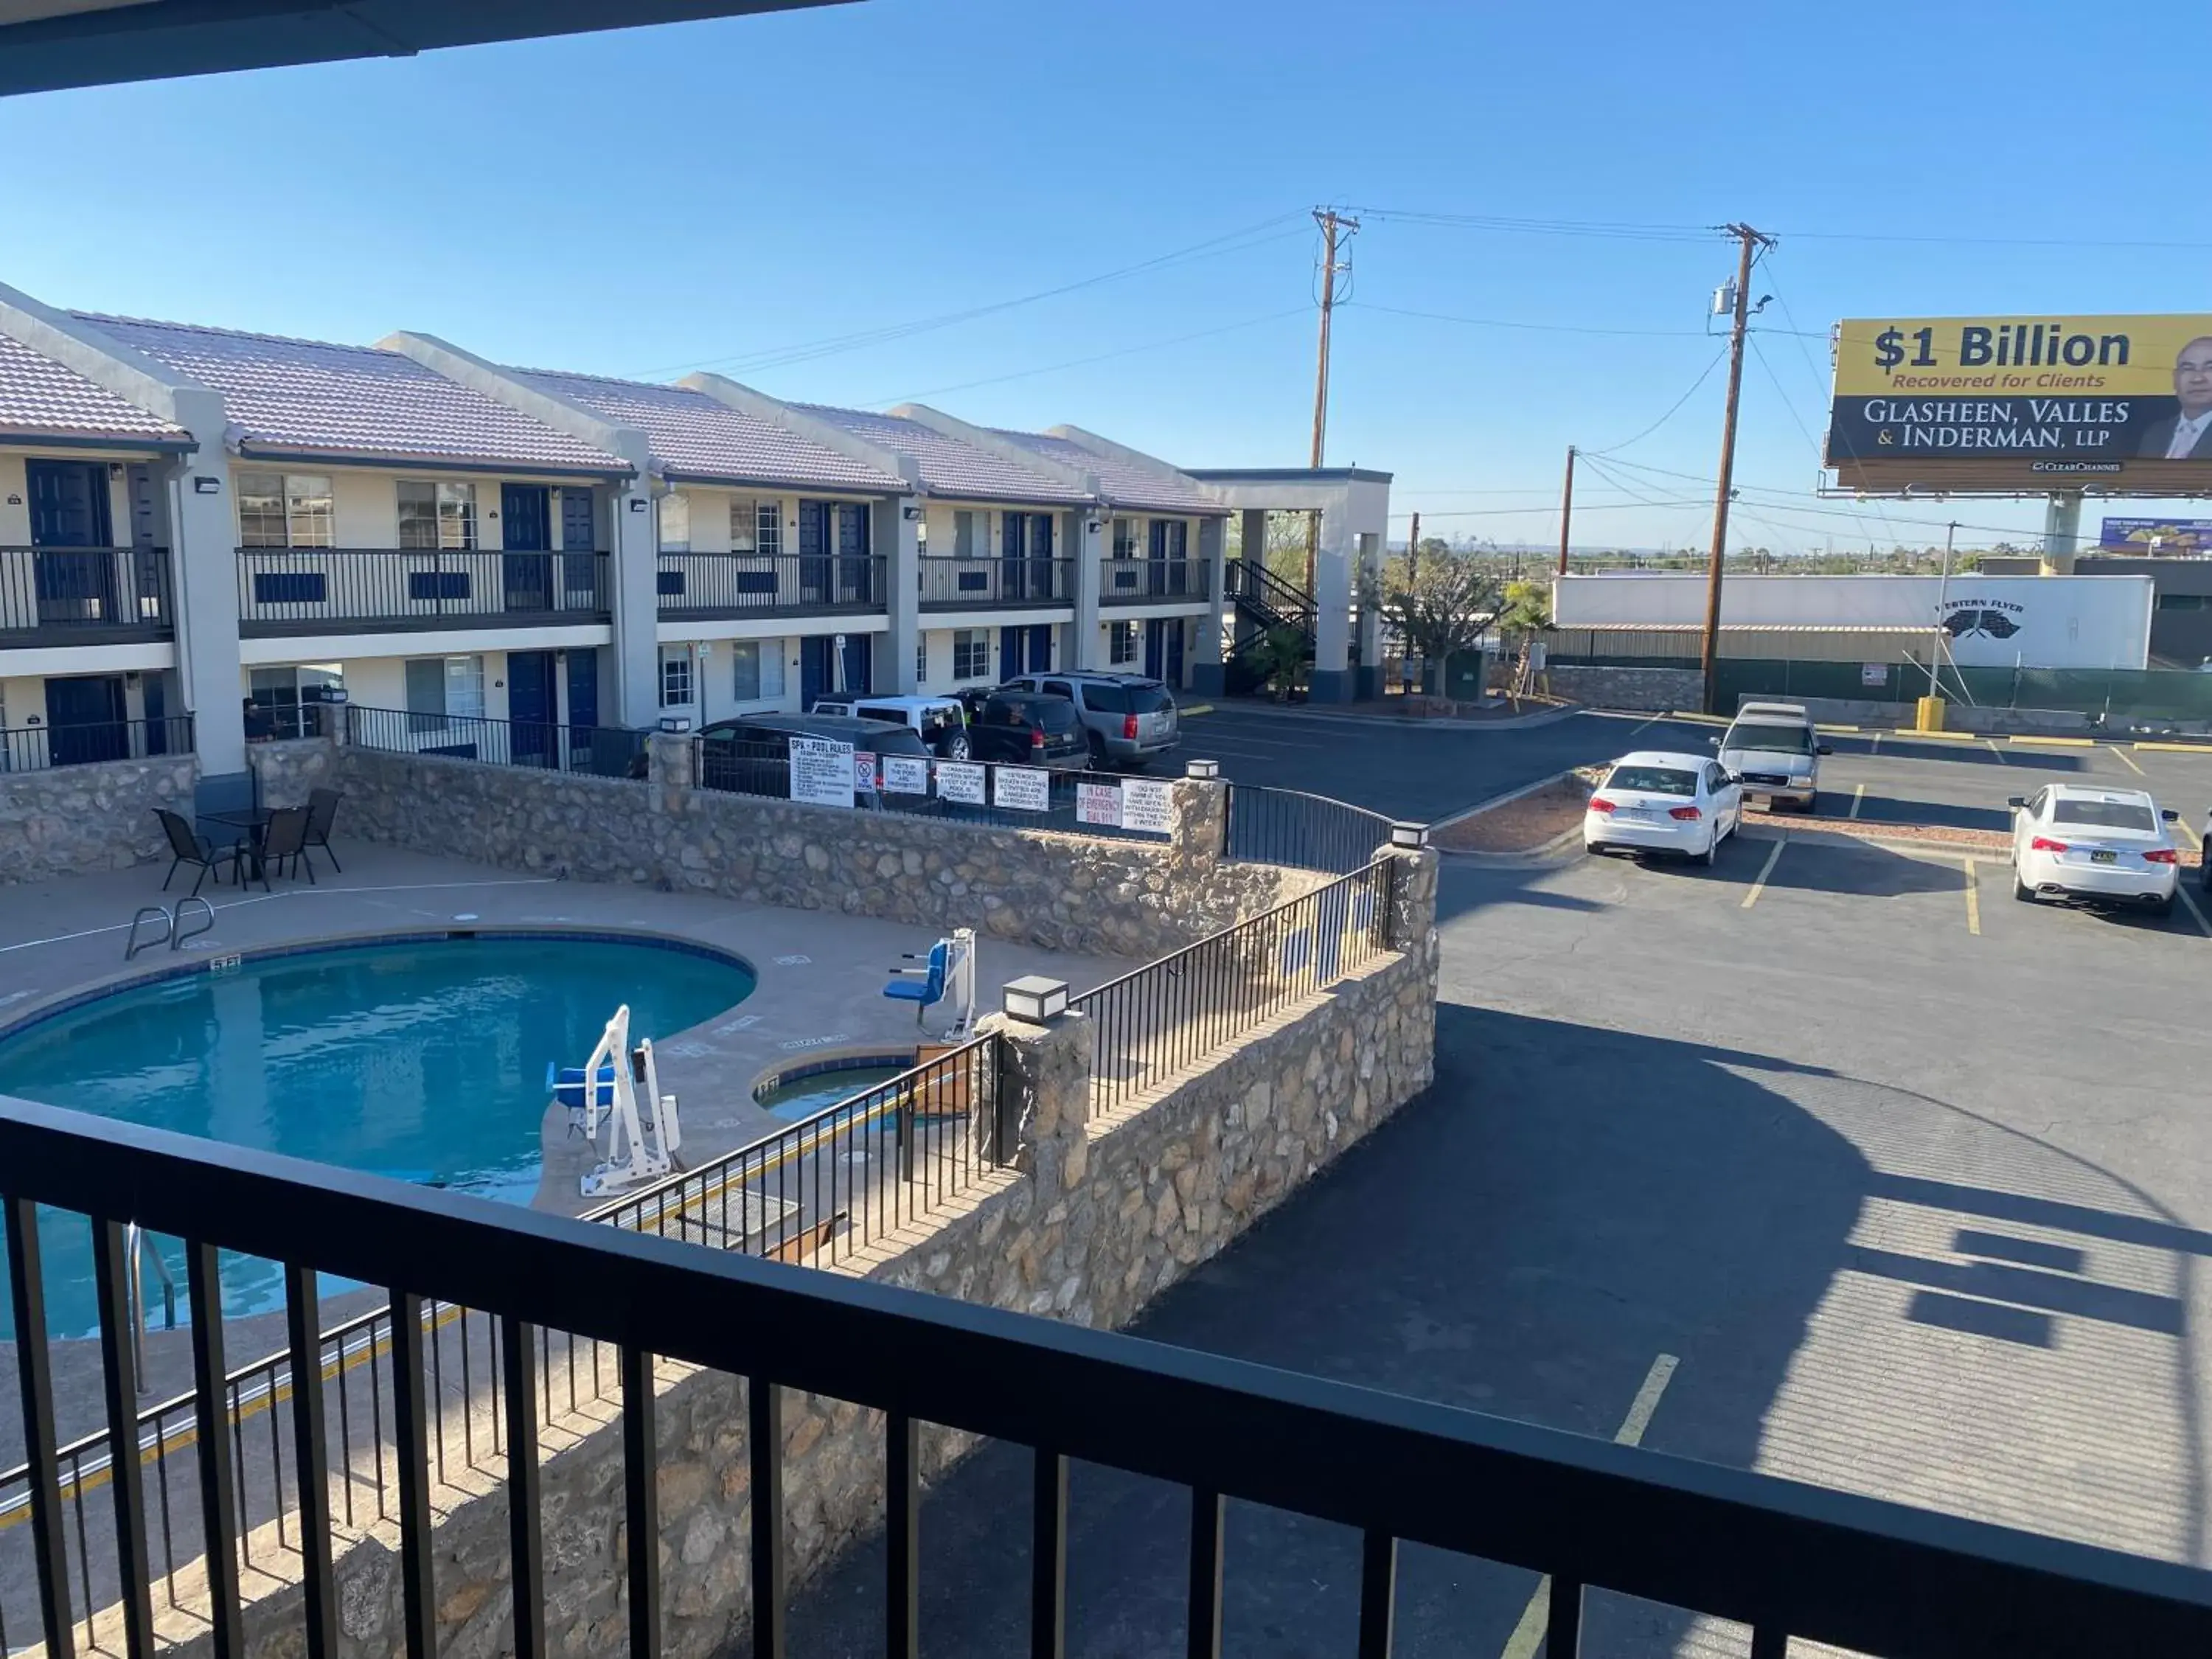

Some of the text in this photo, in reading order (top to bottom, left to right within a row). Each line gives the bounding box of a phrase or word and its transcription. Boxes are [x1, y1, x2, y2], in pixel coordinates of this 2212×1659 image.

[1875, 324, 2129, 375] $1 Billion
[1892, 372, 2107, 388] Recovered for Clients
[1864, 399, 2130, 426] GLASHEEN, VALLES
[1878, 423, 2110, 449] & INDERMAN, LLP
[1991, 599, 2024, 613] FLYER
[792, 740, 804, 750] SPA
[812, 741, 828, 752] POOL
[830, 742, 851, 754] RULES
[1087, 786, 1112, 799] IN CASE
[1079, 796, 1120, 812] OF EMERGENCY
[1087, 810, 1113, 824] DIAL 911
